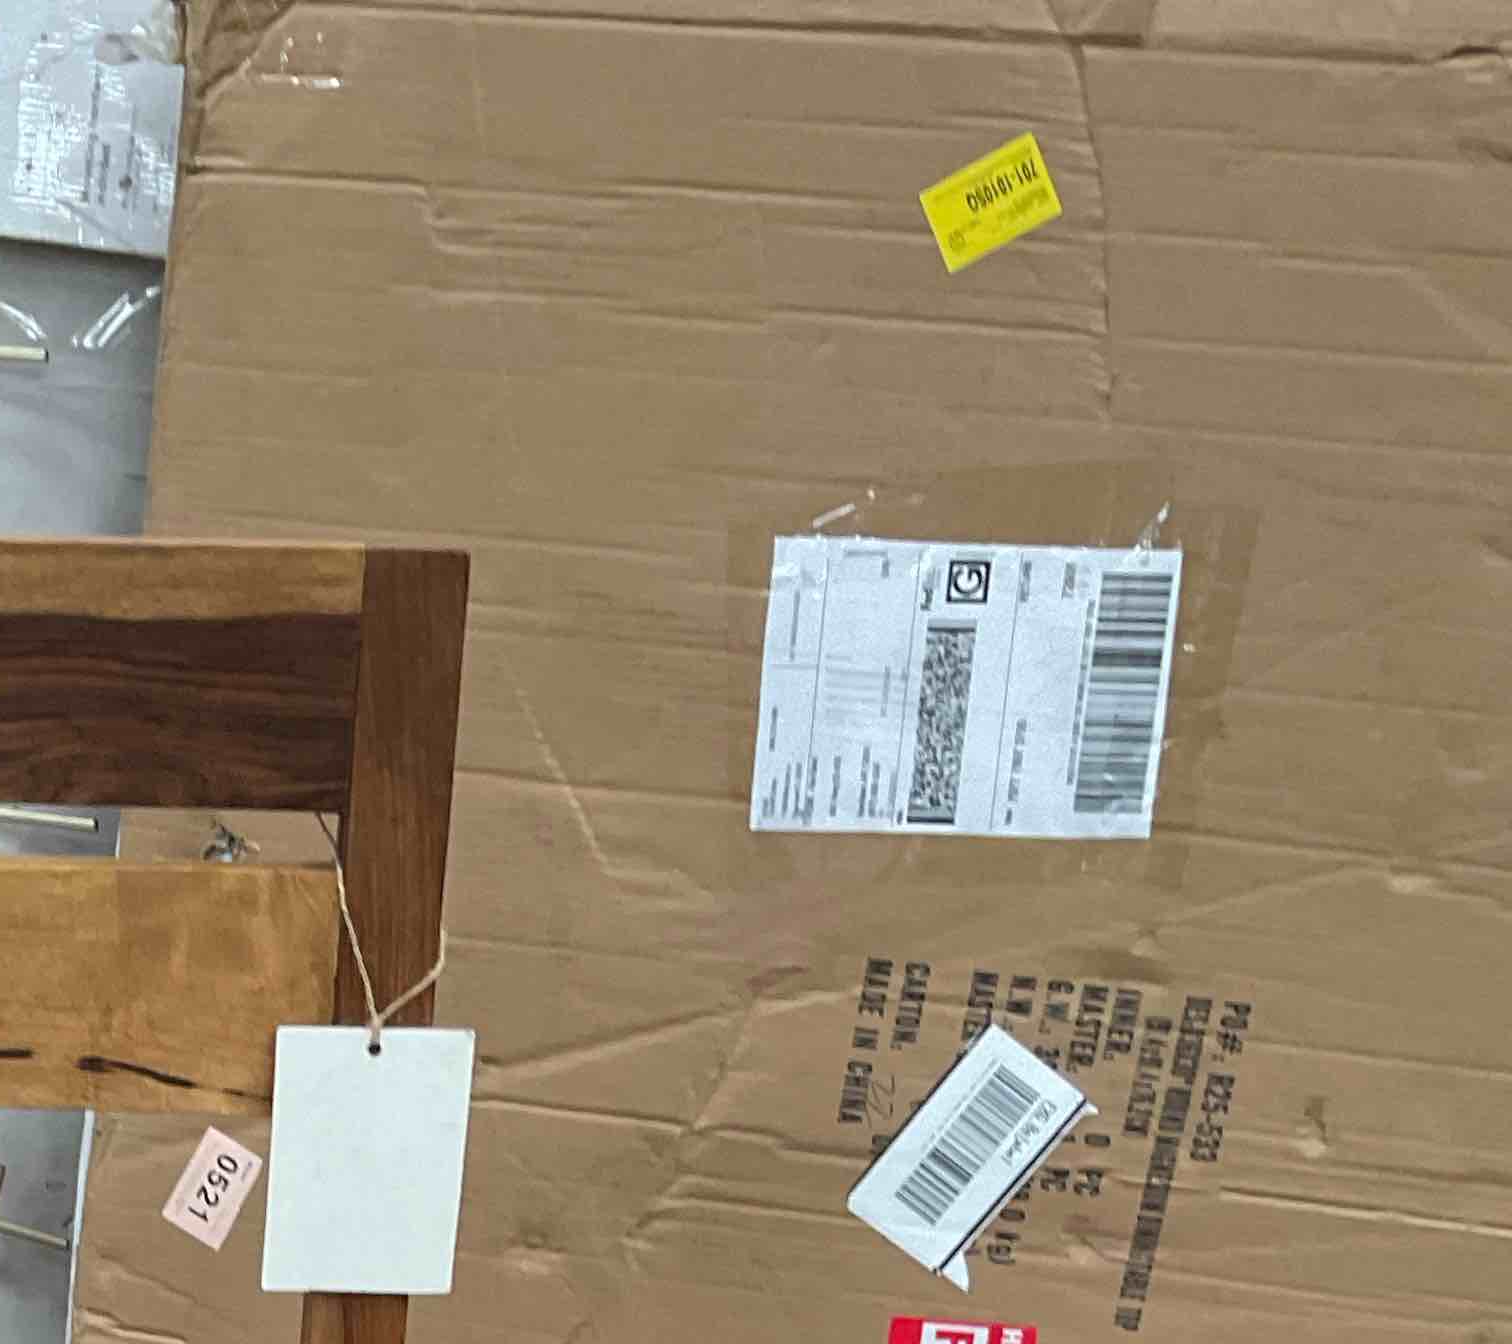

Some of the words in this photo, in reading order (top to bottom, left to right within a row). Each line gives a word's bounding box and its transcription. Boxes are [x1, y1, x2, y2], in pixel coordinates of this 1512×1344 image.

[858, 956, 893, 1018] MADE
[852, 1026, 879, 1050] IN
[838, 1061, 873, 1124] CHINA
[186, 1154, 239, 1225] 0521
